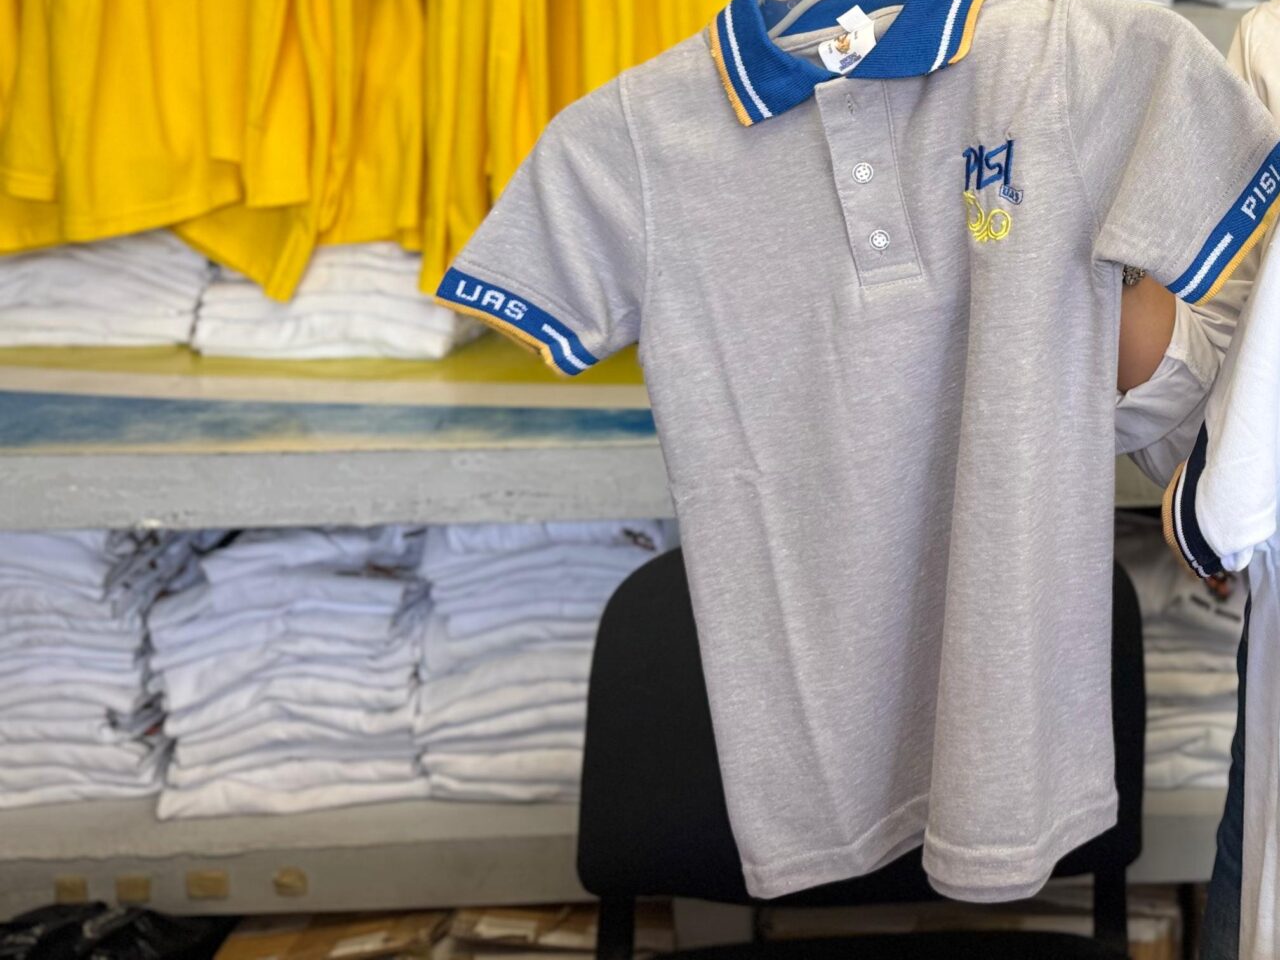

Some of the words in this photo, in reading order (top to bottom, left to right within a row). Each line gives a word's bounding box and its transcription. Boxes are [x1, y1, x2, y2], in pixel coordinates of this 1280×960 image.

[962, 139, 1014, 191] PISI
[1240, 163, 1280, 221] PISI
[455, 279, 528, 321] UAS
